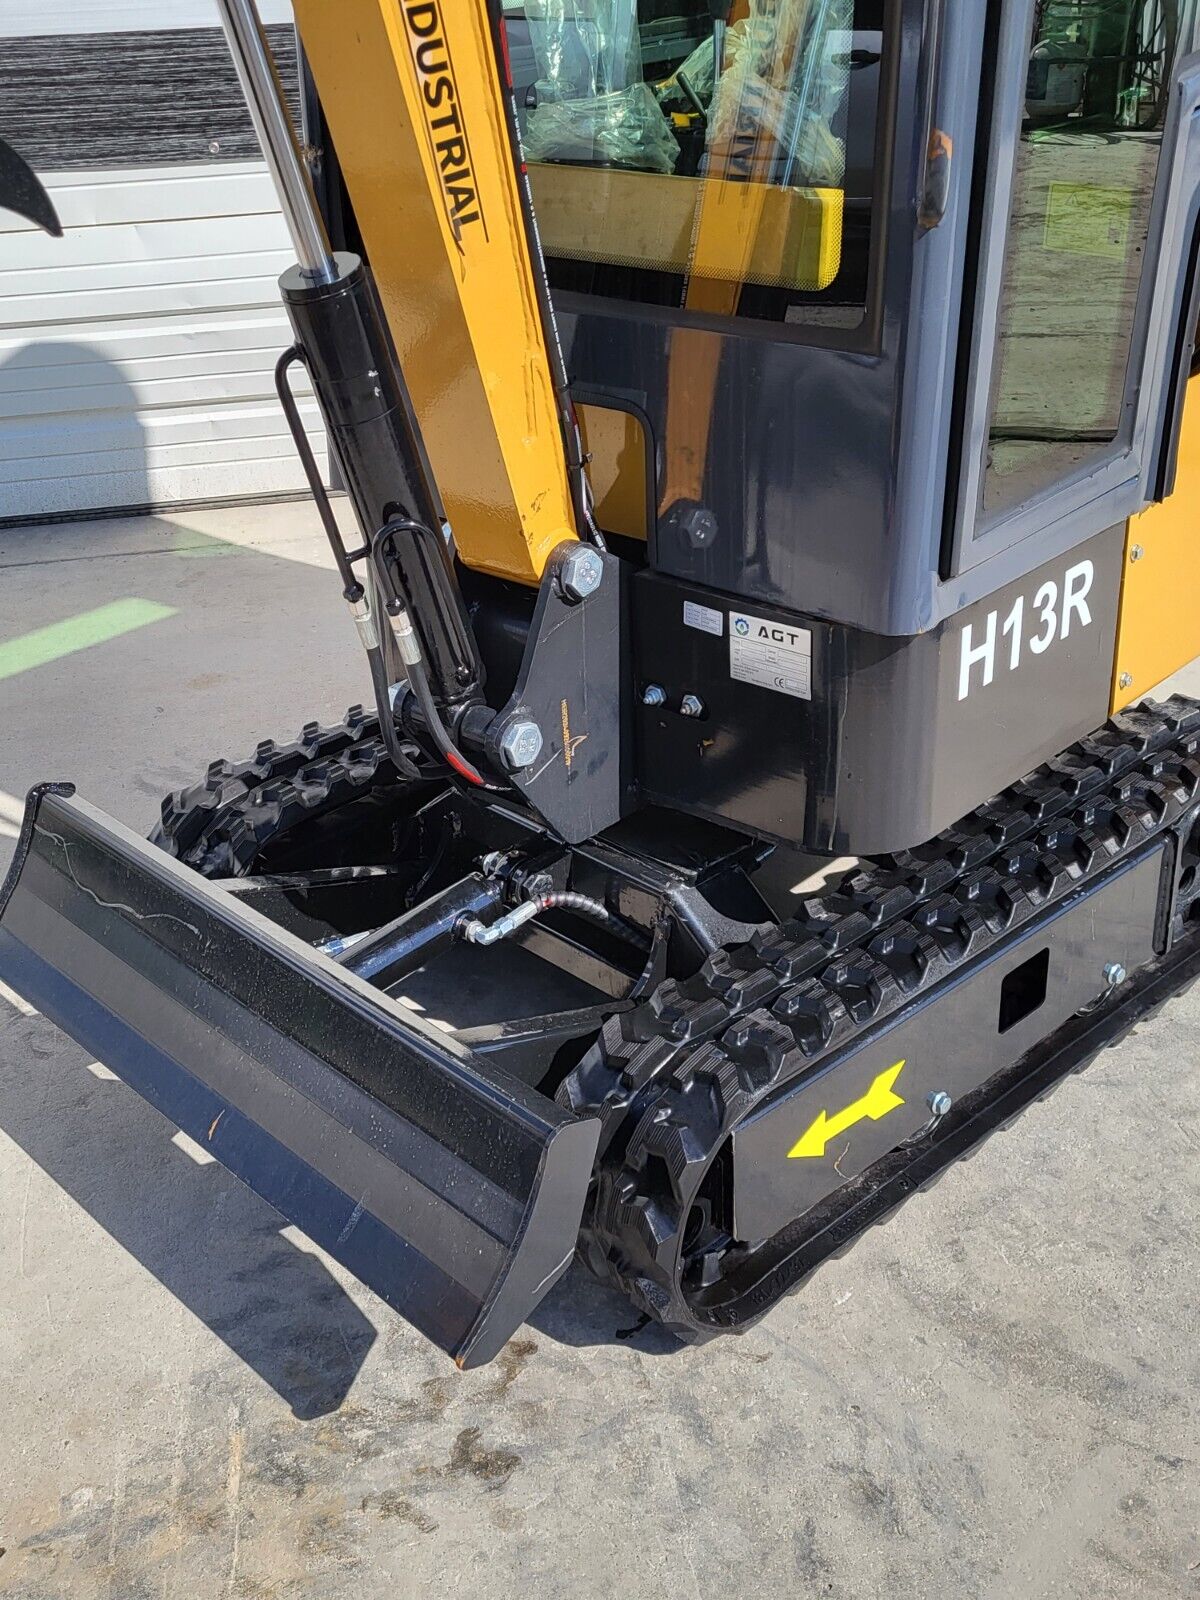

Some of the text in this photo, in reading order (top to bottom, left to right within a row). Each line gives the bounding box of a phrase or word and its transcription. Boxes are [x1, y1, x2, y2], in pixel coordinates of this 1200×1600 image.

[404, 0, 480, 241] DUSTRIAL
[758, 625, 799, 646] AGT
[958, 559, 1094, 701] H13R
